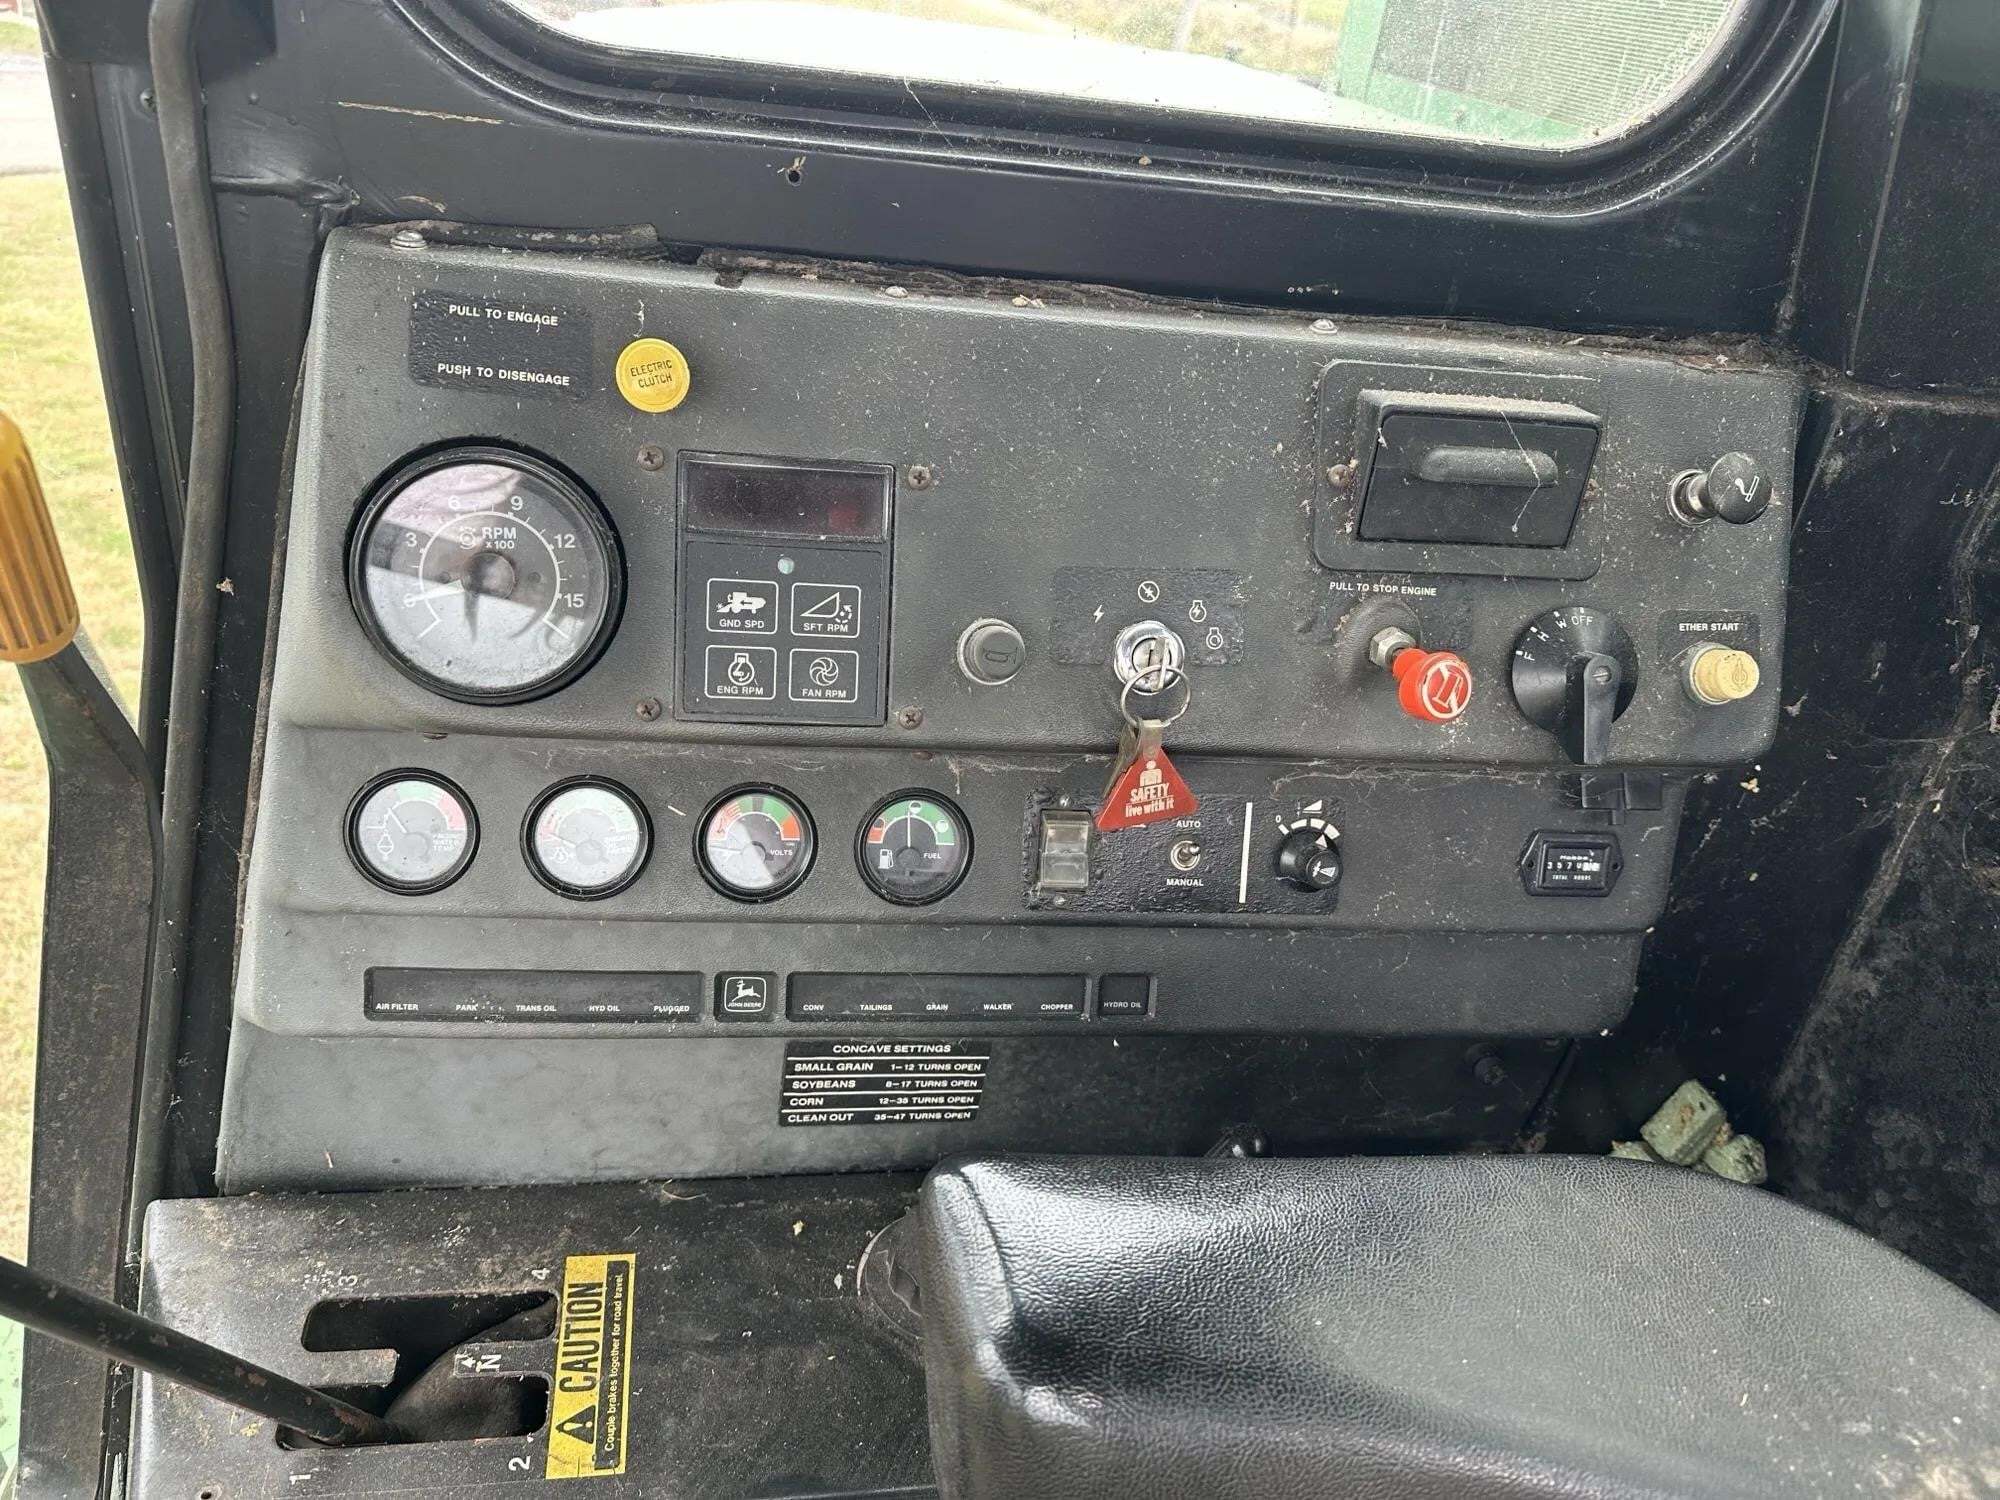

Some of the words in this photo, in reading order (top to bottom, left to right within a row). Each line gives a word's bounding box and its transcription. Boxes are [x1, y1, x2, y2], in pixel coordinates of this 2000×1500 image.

[449, 304, 480, 317] PULL
[485, 308, 502, 319] TO
[507, 311, 559, 327] ENGAGE
[630, 358, 673, 378] ELECTRIC
[437, 362, 471, 377] PUSH
[477, 366, 494, 379] TO
[498, 368, 570, 387] DISENGAGE
[637, 372, 674, 389] CLUTCH
[450, 496, 461, 511] 6
[511, 495, 523, 511] 9
[481, 527, 518, 540] RPM
[406, 533, 418, 548] 3
[554, 534, 576, 549] 12
[1329, 581, 1353, 591] PULL
[1356, 582, 1370, 592] TO
[1373, 584, 1399, 593] STOP
[1401, 586, 1438, 596] ENGINE
[564, 592, 585, 608] 15
[719, 618, 742, 629] GND
[745, 619, 765, 630] SPD
[1571, 615, 1594, 627] OFF
[1679, 623, 1709, 632] ETHER
[1711, 622, 1740, 632] START
[803, 622, 822, 633] SFT
[827, 623, 849, 634] RPM
[1536, 631, 1550, 643] H
[1523, 651, 1535, 662] F
[716, 685, 739, 695] ENG
[742, 686, 764, 697] RPM
[802, 688, 822, 698] FAN
[825, 689, 847, 699] RPM
[1130, 782, 1170, 801] SAFETY
[1125, 804, 1142, 819] live
[1143, 801, 1163, 817] with
[1164, 799, 1175, 812] it
[1176, 820, 1202, 829] AUTO
[770, 849, 793, 857] VOLTS
[923, 852, 942, 860] FUEL
[1166, 878, 1204, 887] MANUAL
[376, 1003, 390, 1011] AIR
[391, 1003, 419, 1012] FILTER
[456, 1004, 477, 1012] PARK
[516, 1004, 539, 1013] TRANS
[541, 1005, 557, 1013] OIL
[589, 1005, 606, 1013] HYD
[608, 1005, 620, 1013] OIL
[653, 1005, 690, 1013] PLUGGED
[926, 1003, 949, 1011] GRAIN
[1041, 1003, 1074, 1011] CHOPPER
[833, 1044, 891, 1054] CONCAVE
[894, 1044, 951, 1053] SETTINGS
[794, 1062, 834, 1072] SMALL
[836, 1062, 874, 1072] GRAIN
[918, 1063, 951, 1071] TURNS
[954, 1063, 981, 1071] OPEN
[792, 1079, 856, 1090] SOYBEANS
[914, 1080, 948, 1088] TURNS
[789, 1097, 824, 1106] CORN
[912, 1096, 945, 1104] TURNS
[947, 1096, 974, 1104] OPEN
[787, 1113, 827, 1122] CLEAN
[829, 1113, 855, 1122] OUT
[908, 1112, 942, 1120] TURNS
[944, 1111, 971, 1120] OPEN
[531, 1267, 550, 1280] 4
[338, 1275, 358, 1287] 3
[614, 1273, 623, 1298] travel
[613, 1300, 622, 1321] road
[611, 1322, 620, 1336] for
[559, 1281, 604, 1393] CAUTION
[481, 1354, 502, 1370] N
[609, 1337, 620, 1378] together
[607, 1379, 617, 1414] brakes
[605, 1415, 615, 1451] Couple
[508, 1455, 531, 1471] 2
[289, 1473, 311, 1485] 1
